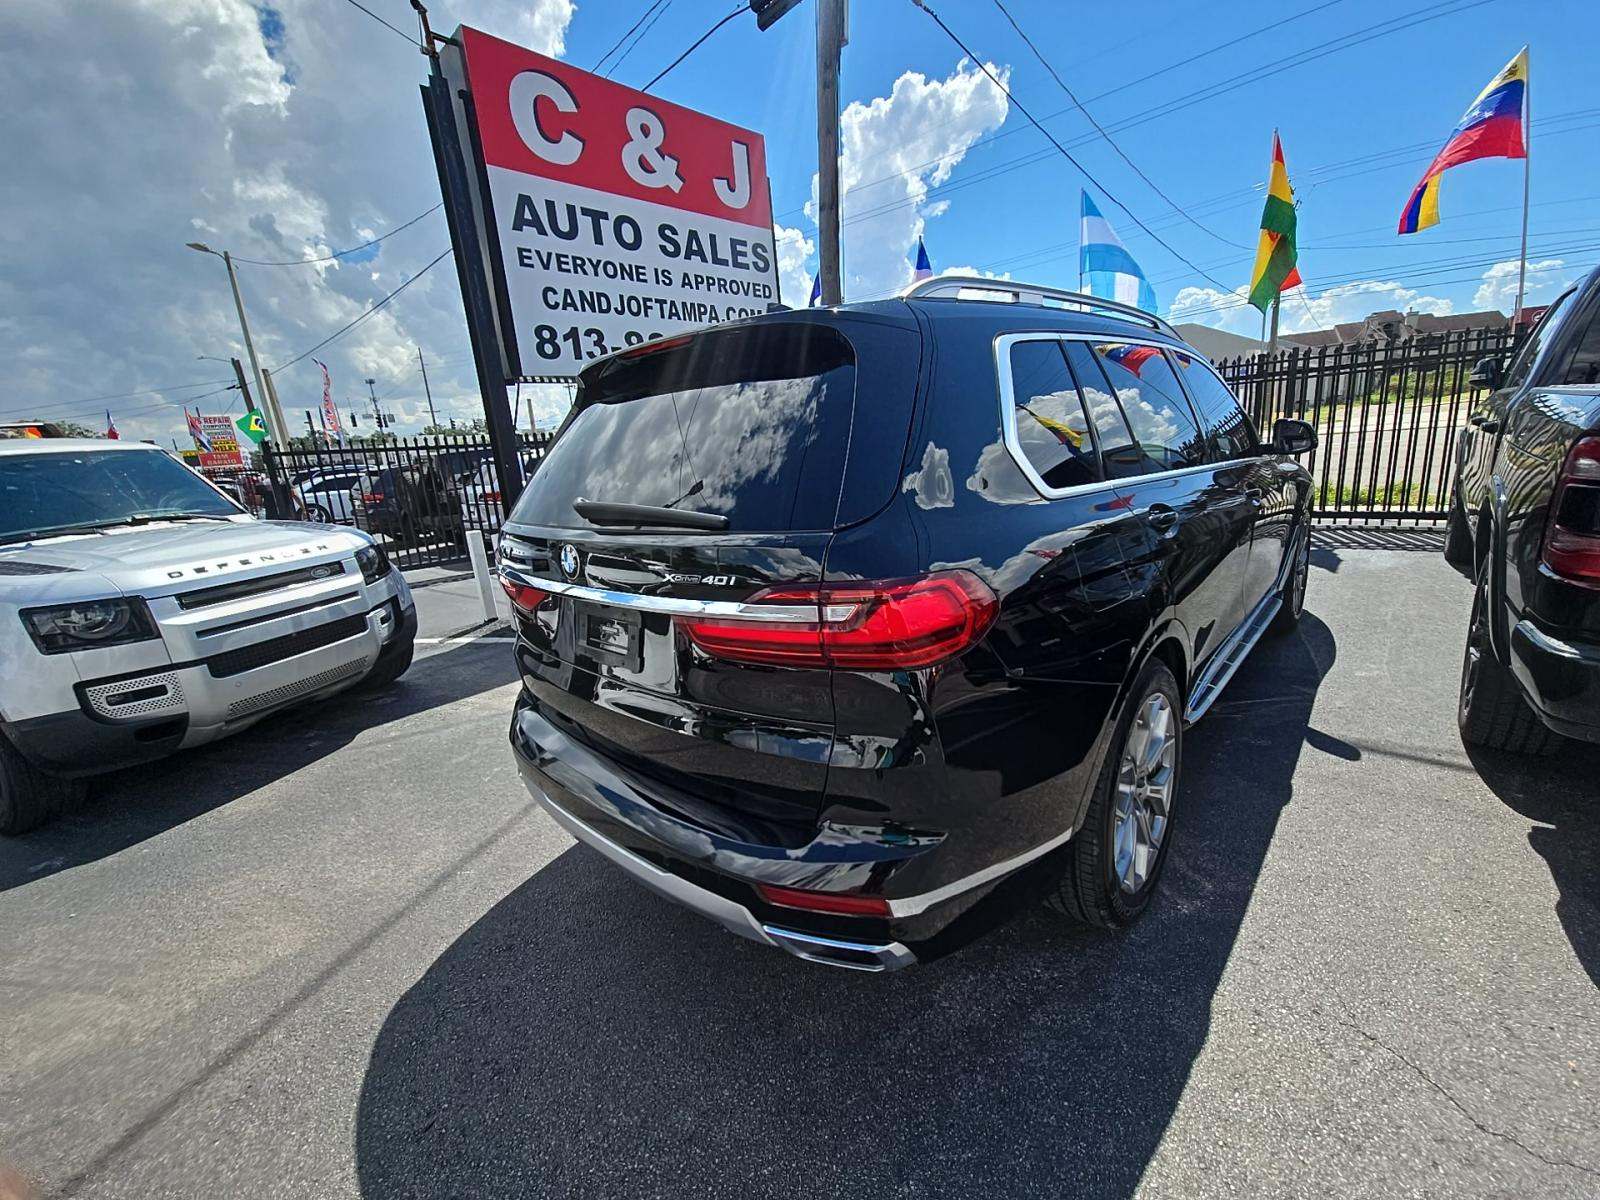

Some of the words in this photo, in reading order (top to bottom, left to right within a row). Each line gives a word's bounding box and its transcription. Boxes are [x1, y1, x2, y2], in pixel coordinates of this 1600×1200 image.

[508, 69, 586, 166] C
[621, 107, 687, 195] &
[712, 140, 753, 210] J
[511, 192, 643, 252] AUTO
[657, 223, 771, 274] SALES
[516, 246, 649, 284] EVERYONE
[653, 267, 674, 288] IS
[681, 272, 773, 299] APPROVED
[533, 324, 665, 361] 813-
[167, 544, 328, 579] DEFENER
